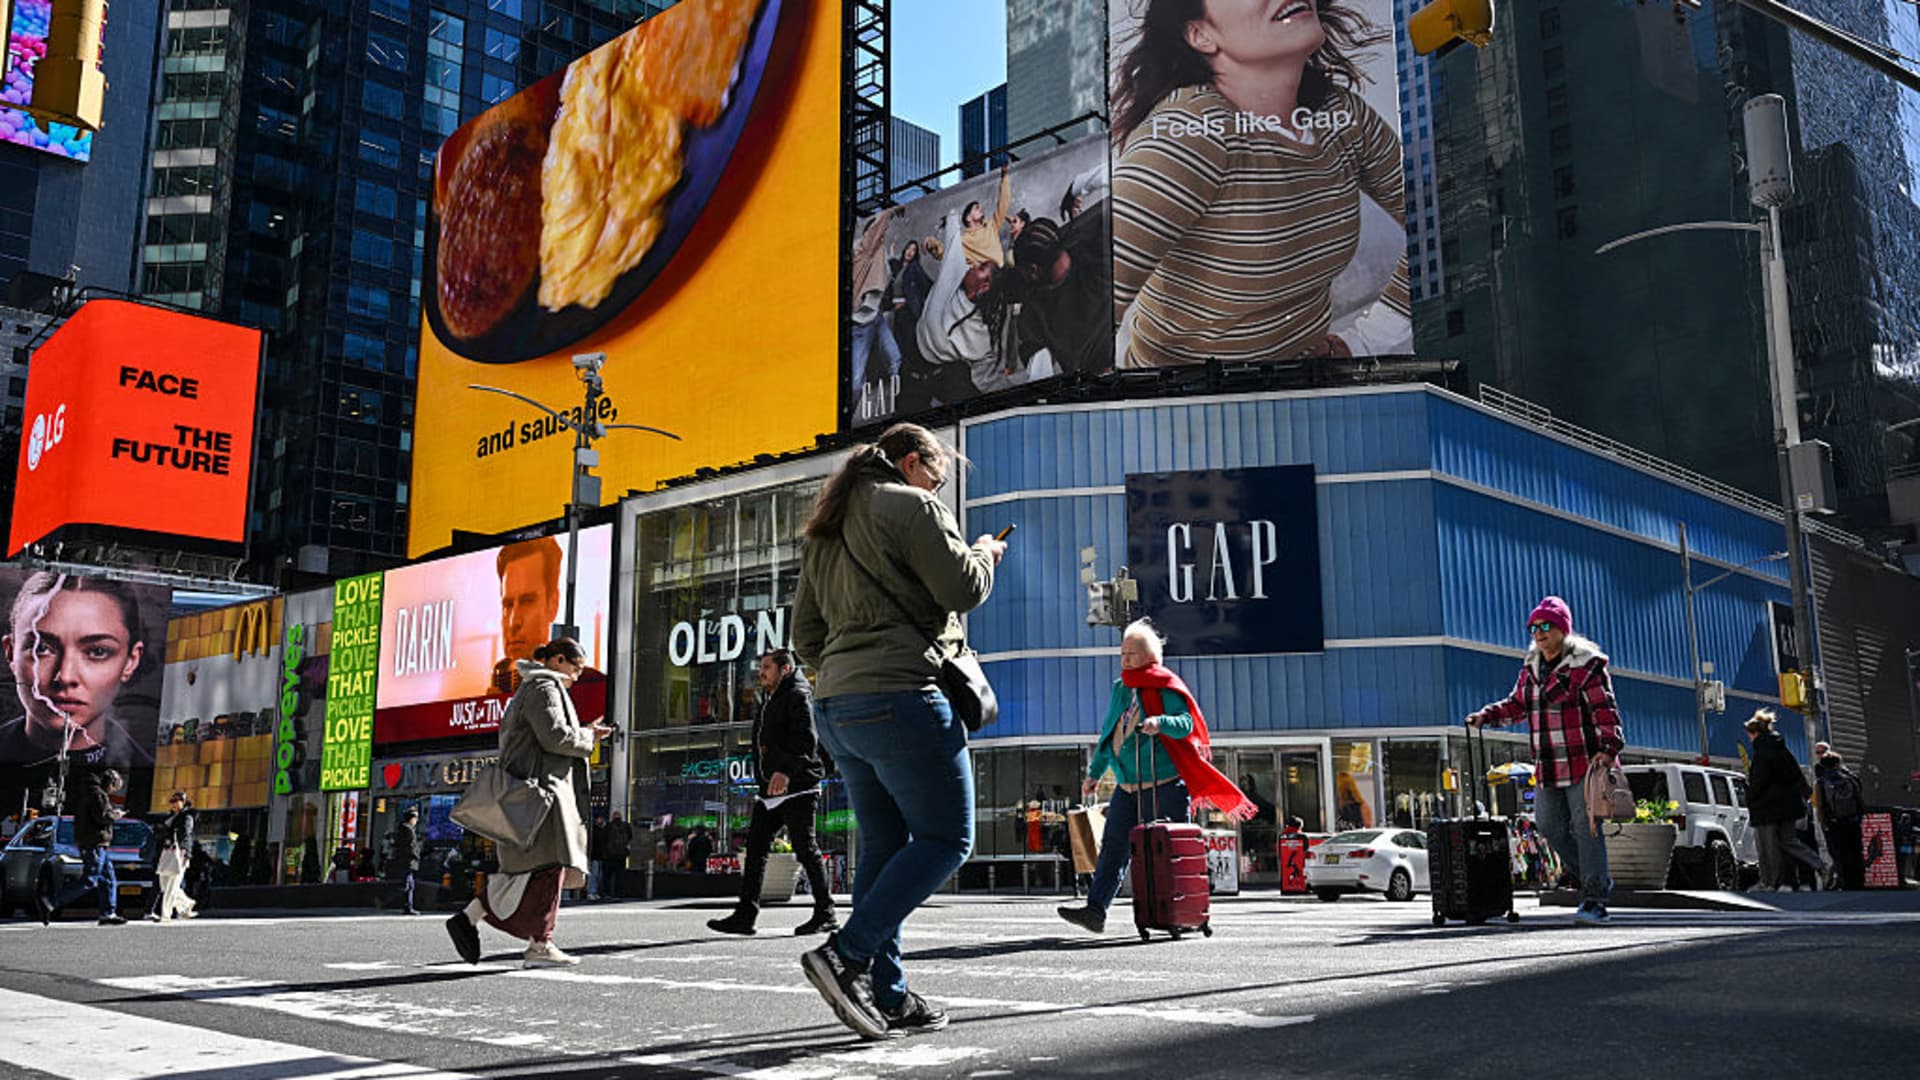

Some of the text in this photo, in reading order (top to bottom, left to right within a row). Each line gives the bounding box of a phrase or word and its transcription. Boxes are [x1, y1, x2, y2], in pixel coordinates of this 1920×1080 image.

[1152, 107, 1358, 140] Feels like Gap.
[119, 366, 199, 400] FACE
[862, 374, 901, 420] GAP
[44, 403, 66, 453] LG
[174, 424, 232, 453] THE
[477, 421, 514, 458] and
[112, 438, 231, 476] FUTURE
[1168, 520, 1278, 602] GAP
[335, 576, 380, 607] LOVE
[335, 601, 379, 631] THAT
[332, 624, 377, 649] PICKLE
[394, 599, 457, 677] DARIN.
[669, 614, 745, 666] OLD
[757, 607, 796, 656] N
[330, 645, 376, 673] LOVE
[329, 670, 374, 698] THAT
[327, 695, 373, 718] PICKLE
[449, 701, 477, 726] JUST
[483, 697, 513, 722] TIM
[325, 716, 371, 744] LOVE
[323, 742, 369, 769] THAT
[443, 756, 499, 785] GIF
[322, 766, 368, 789] PICKLE
